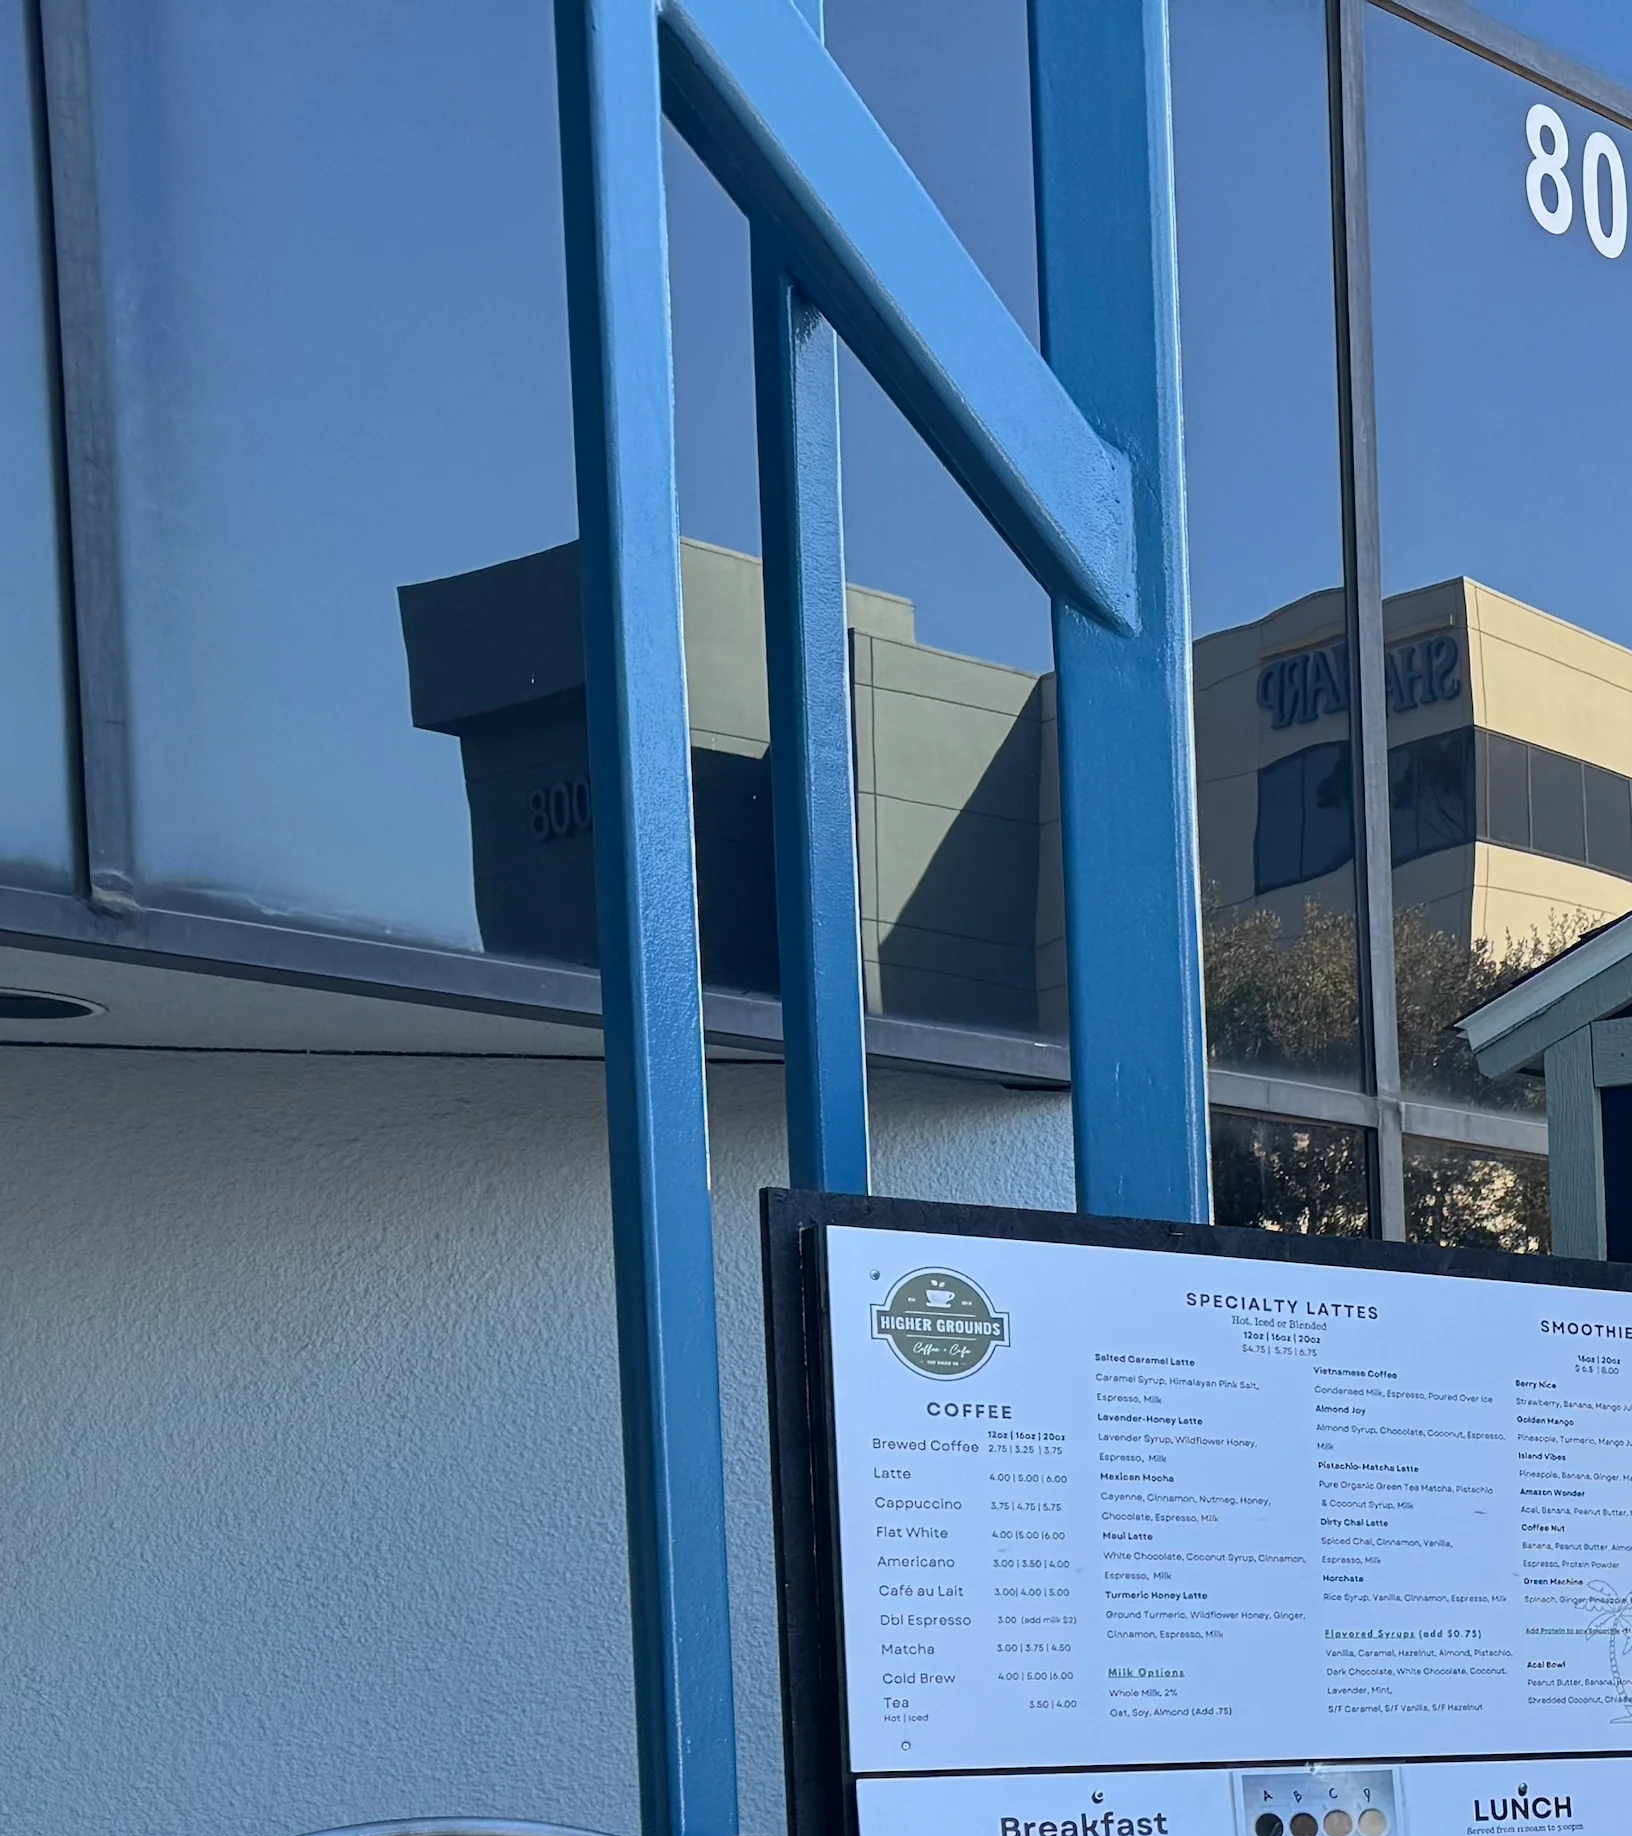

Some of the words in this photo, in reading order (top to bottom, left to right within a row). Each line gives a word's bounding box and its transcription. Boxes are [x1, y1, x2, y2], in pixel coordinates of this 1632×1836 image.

[1185, 1291, 1298, 1315] SPECIALTY
[1307, 1301, 1378, 1319] LATTES
[881, 1316, 932, 1332] HIGHER
[937, 1319, 1000, 1335] GROUNDS
[1095, 1353, 1126, 1362] Salted
[1128, 1355, 1168, 1365] Caramel
[1170, 1358, 1195, 1366] Latte
[1313, 1366, 1366, 1377] Vietnamese
[1368, 1370, 1397, 1379] Coffee
[1515, 1380, 1537, 1389] Berry
[1539, 1381, 1556, 1389] Nice
[927, 1402, 1012, 1419] COFFEE
[1316, 1405, 1349, 1413] Almond
[1352, 1407, 1366, 1416] Joy
[1098, 1413, 1176, 1426] Lavender-Honey
[1178, 1417, 1203, 1425] Latte
[873, 1438, 926, 1450] Brewed
[931, 1440, 979, 1452] Coffee
[874, 1467, 911, 1479] Latte
[1318, 1461, 1395, 1472] Pistachio-Matcha
[1100, 1472, 1140, 1481] Mexican
[1143, 1474, 1174, 1482] Mocha
[875, 1497, 962, 1511] Cappuccino
[877, 1526, 902, 1538] Flat
[906, 1527, 948, 1539] White
[877, 1555, 955, 1568] Americano
[879, 1584, 913, 1596] Café
[917, 1588, 934, 1596] au
[938, 1585, 964, 1597] Lait
[880, 1614, 903, 1625] Dbl
[908, 1615, 971, 1628] Espresso
[1325, 1629, 1375, 1639] Flavored
[1375, 1629, 1416, 1639] Syrups
[1419, 1629, 1443, 1639] (add
[1447, 1629, 1481, 1639] $0.75)
[882, 1643, 934, 1655] Matcha
[883, 1672, 915, 1684] Cold
[920, 1673, 955, 1684] Brew
[1108, 1668, 1136, 1678] Milk
[1136, 1668, 1185, 1678] Options
[883, 1697, 909, 1709] Tea
[1474, 1796, 1572, 1821] LUNCH
